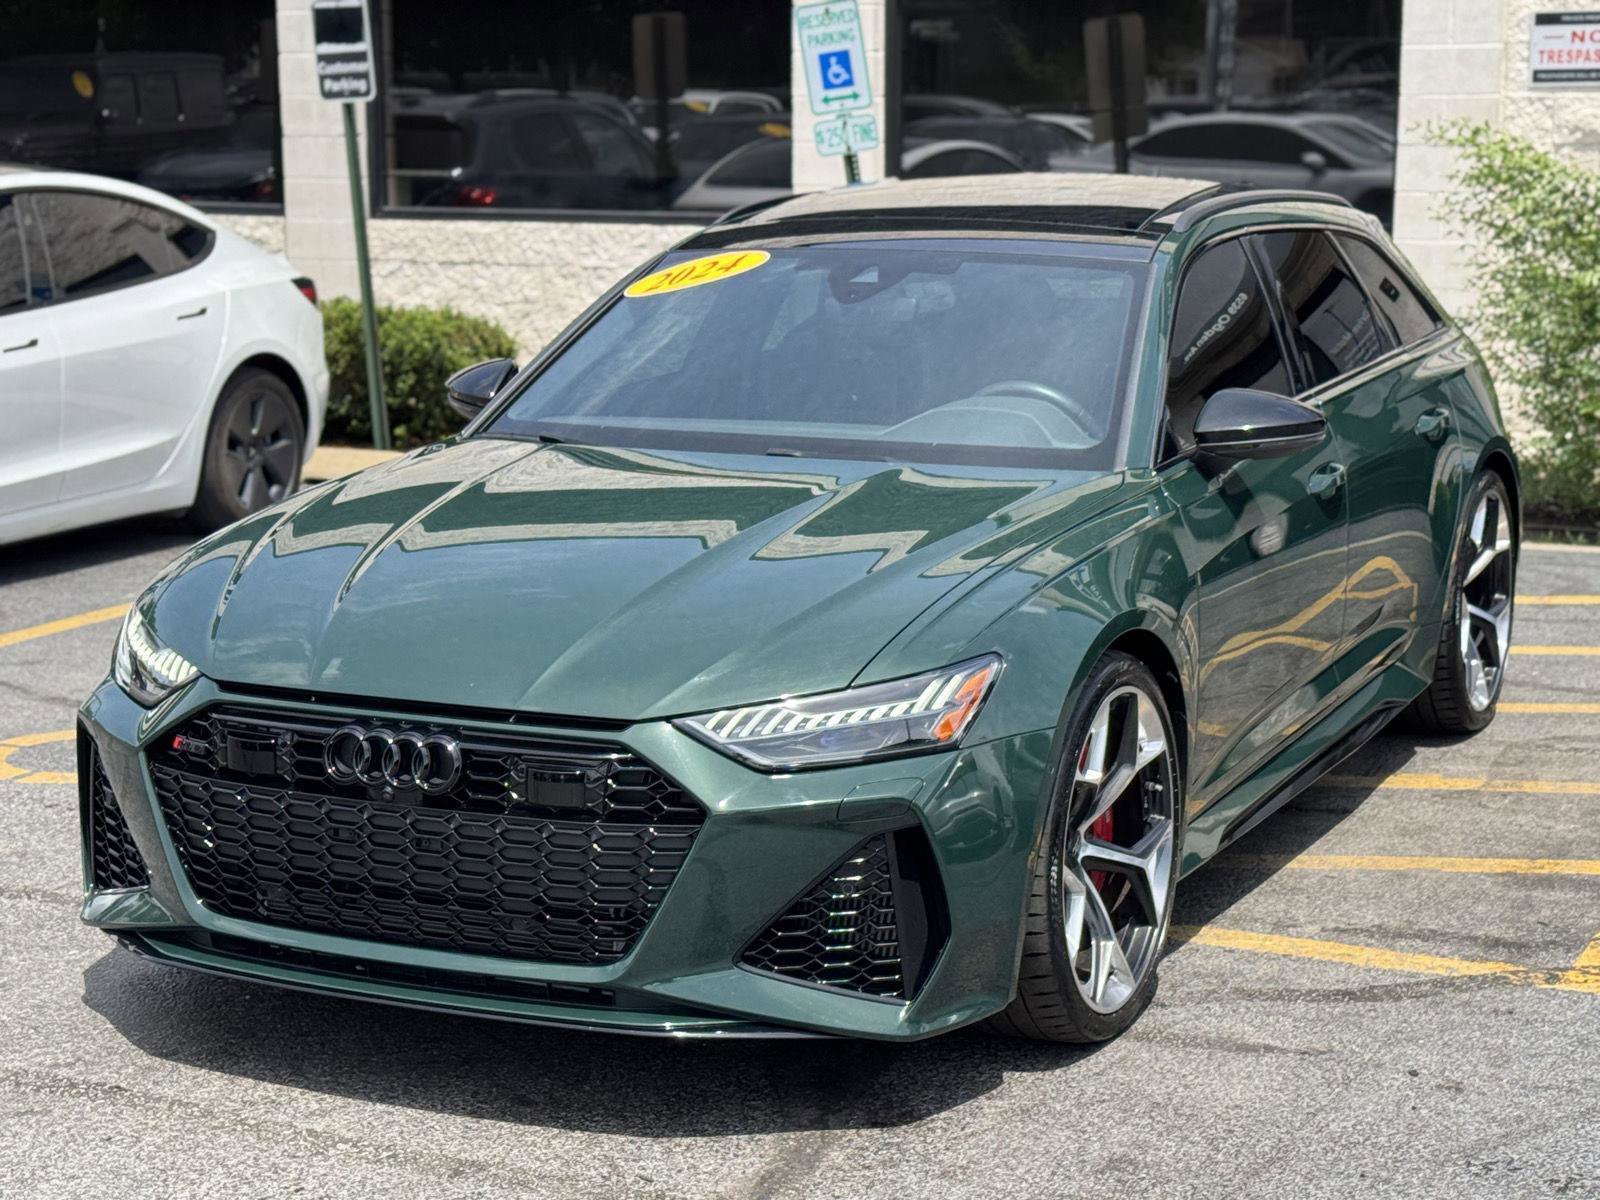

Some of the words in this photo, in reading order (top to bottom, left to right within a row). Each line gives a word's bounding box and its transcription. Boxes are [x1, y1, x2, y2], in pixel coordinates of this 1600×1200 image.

[798, 9, 856, 28] RESERVED
[807, 28, 855, 47] PARKING
[323, 77, 368, 95] Parking
[853, 122, 878, 143] FINE
[643, 254, 748, 293] 2024
